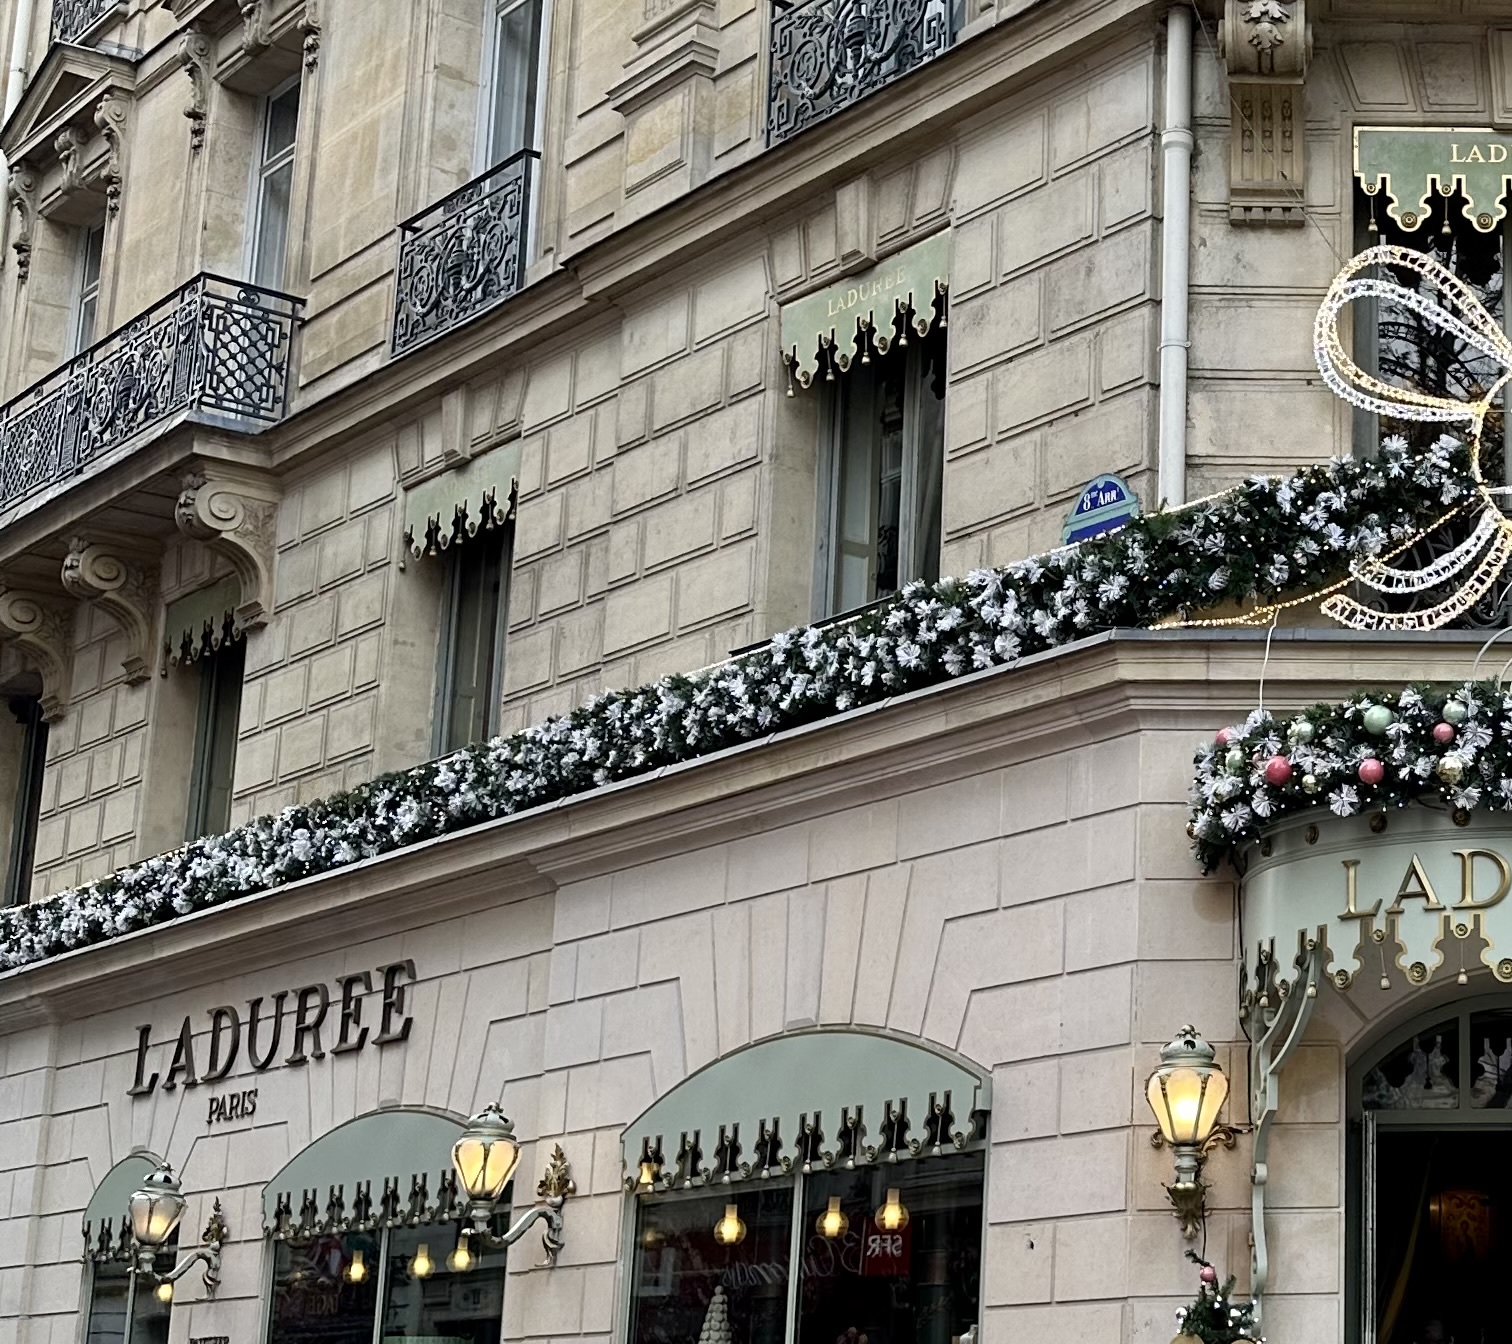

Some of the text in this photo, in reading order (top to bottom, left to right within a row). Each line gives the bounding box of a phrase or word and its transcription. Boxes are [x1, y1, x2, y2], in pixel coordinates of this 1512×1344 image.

[827, 264, 907, 317] LADUREE
[126, 958, 416, 1097] LADUREE
[206, 1089, 259, 1124] PARIS
